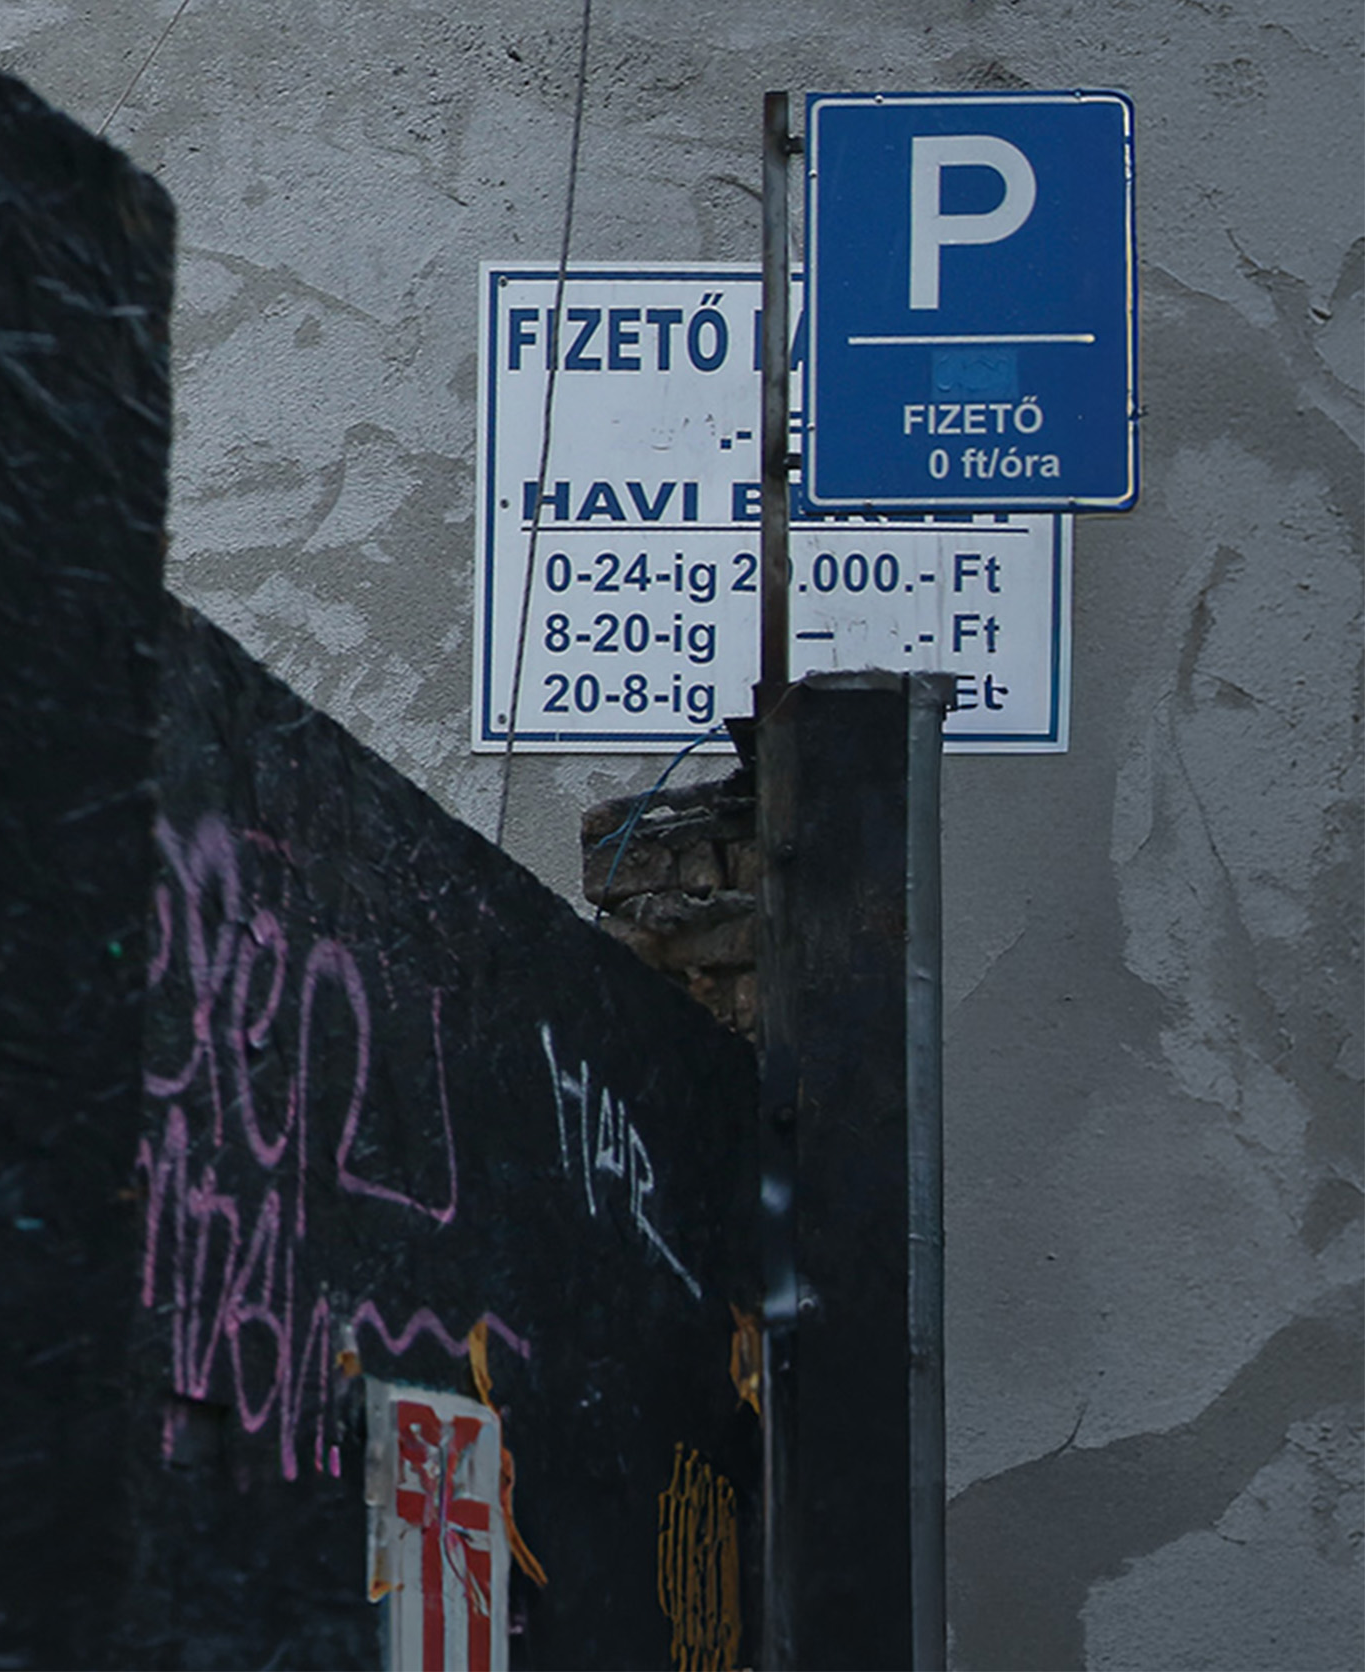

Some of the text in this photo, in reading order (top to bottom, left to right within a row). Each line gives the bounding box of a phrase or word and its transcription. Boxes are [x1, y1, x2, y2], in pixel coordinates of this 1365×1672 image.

[909, 135, 1037, 310] P
[507, 292, 729, 373] FIZETŐ
[903, 395, 1044, 435] FIZETŐ
[928, 446, 1061, 479] 0 ft/óra
[522, 481, 699, 522] HAVI
[545, 552, 1002, 604] 0-24-ig 2.000.- Ft
[543, 612, 716, 665] 8-20-ig
[952, 613, 1001, 654] Ft
[541, 673, 715, 725] 20-8-ig
